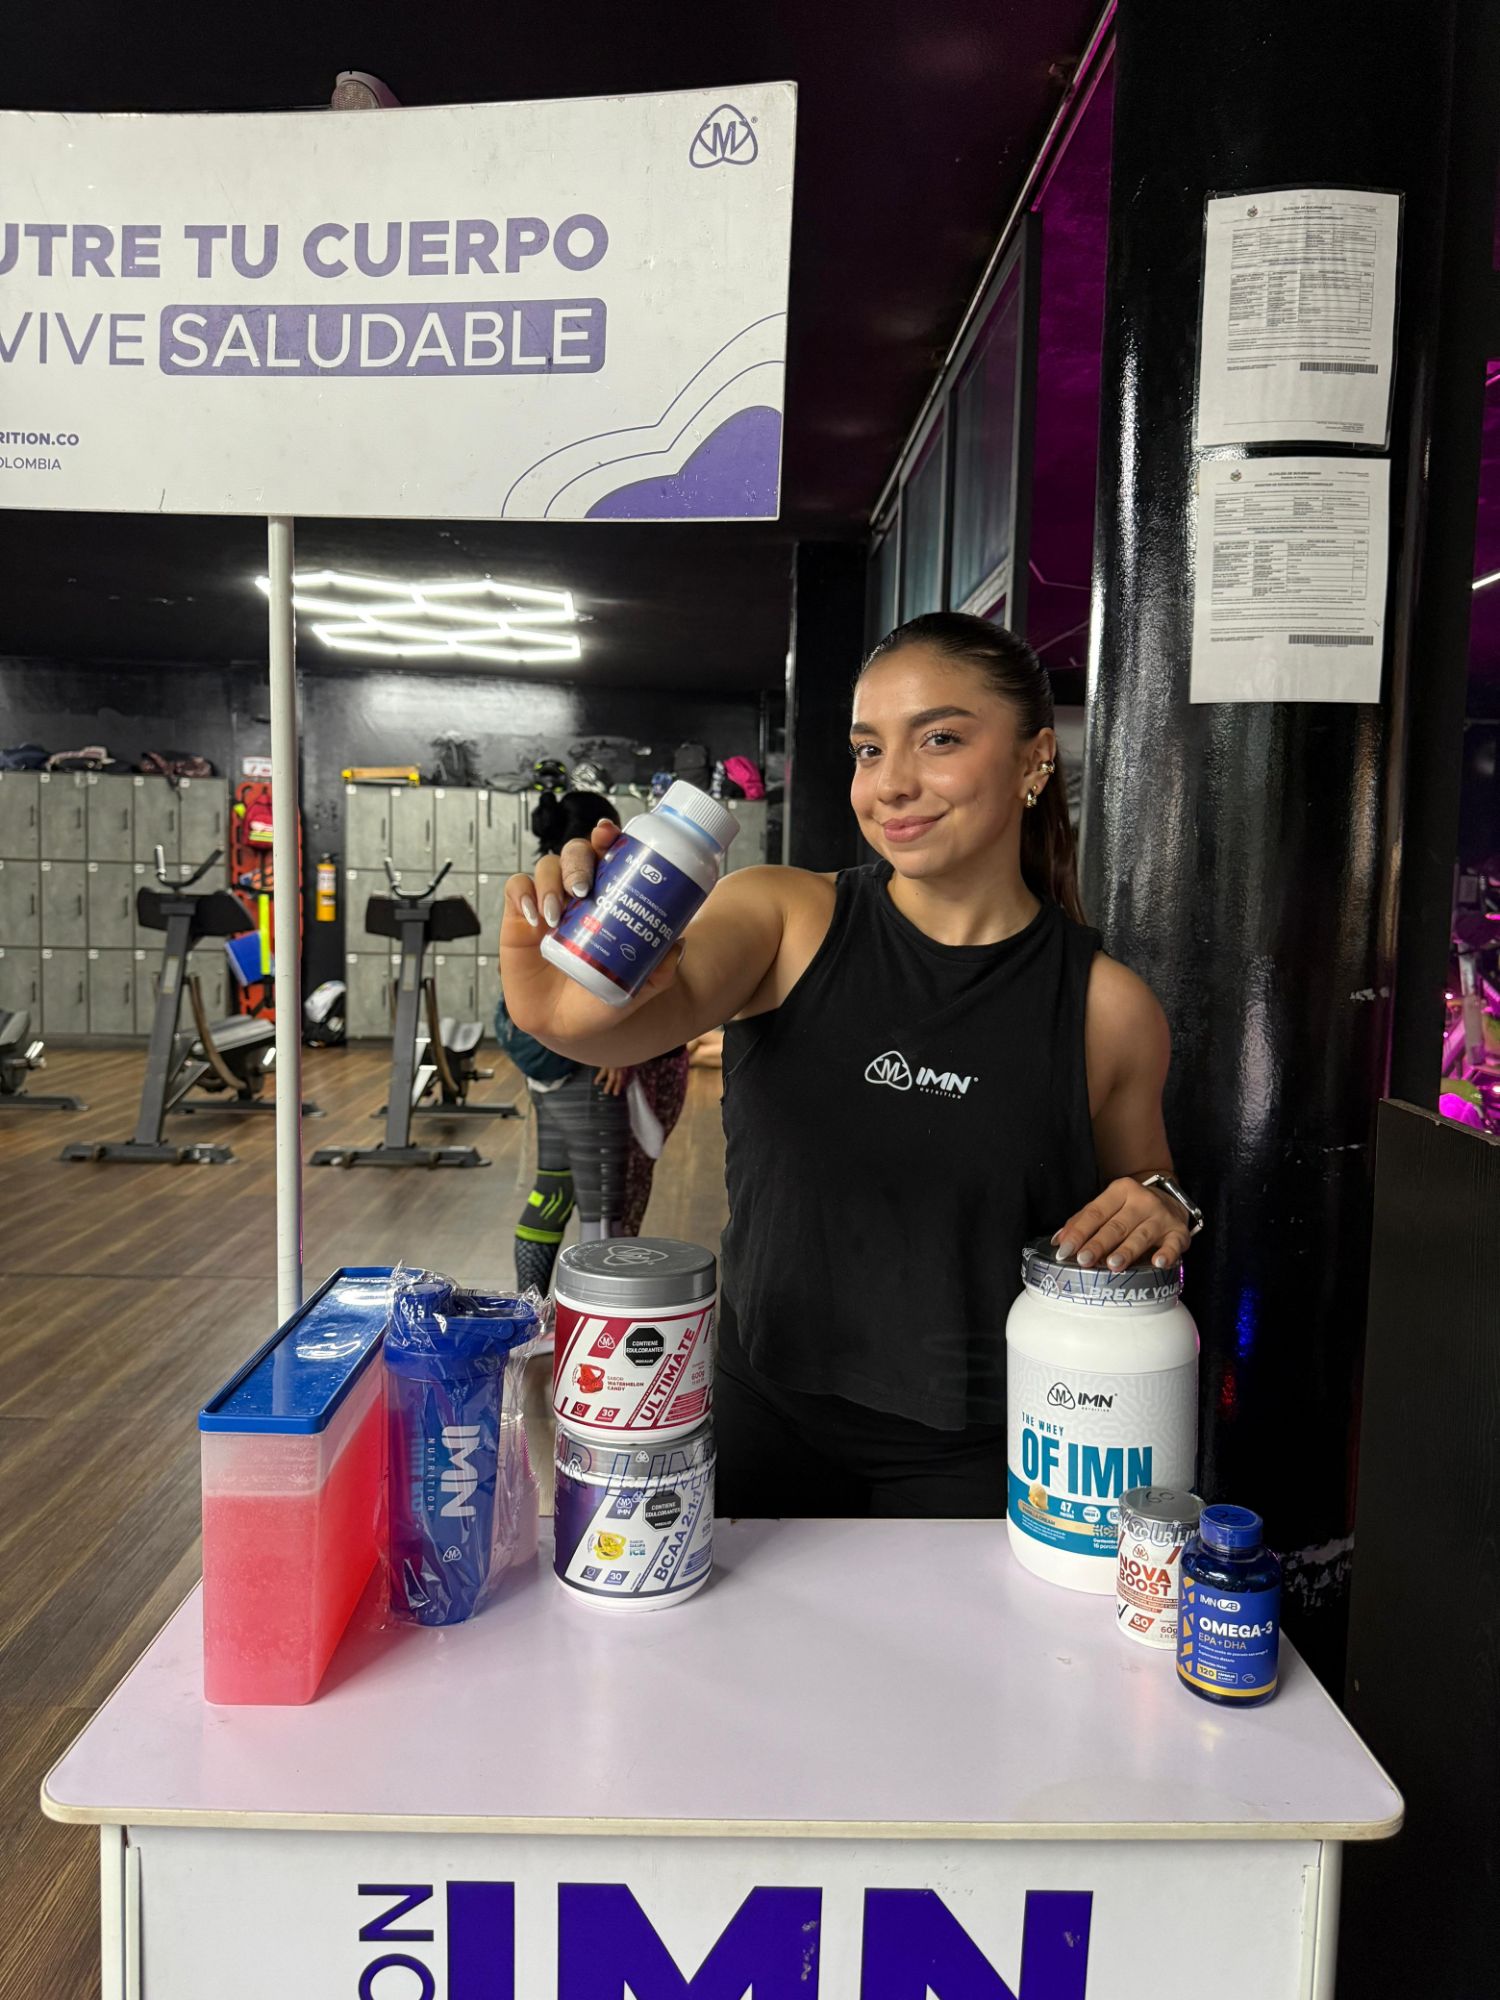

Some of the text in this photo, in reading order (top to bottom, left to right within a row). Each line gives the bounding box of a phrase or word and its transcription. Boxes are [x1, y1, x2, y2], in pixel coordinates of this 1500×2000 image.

[184, 224, 279, 279] TU
[303, 213, 609, 278] CUERPO
[170, 308, 592, 369] SALUDABLE
[596, 895, 655, 943] COMPLEJO
[658, 923, 674, 940] DEL
[915, 1066, 972, 1095] IMN
[1090, 1286, 1150, 1301] BREAK
[640, 1327, 696, 1421] ULTIMATE
[602, 1409, 615, 1417] 30
[1078, 1391, 1114, 1409] IMN
[1022, 1411, 1064, 1437] THE WHEY
[427, 1437, 436, 1511] NUTRITION
[440, 1425, 481, 1517] IMN
[1022, 1427, 1153, 1499] OF IMN
[653, 1530, 688, 1582] BCAA
[1119, 1552, 1171, 1585] NOVA
[610, 1572, 622, 1581] 30
[1119, 1567, 1172, 1597] BOOST
[1199, 1593, 1240, 1612] IMN LAB
[1133, 1615, 1150, 1628] 60
[1199, 1617, 1273, 1638] OMEGA-3
[1200, 1666, 1215, 1677] 120
